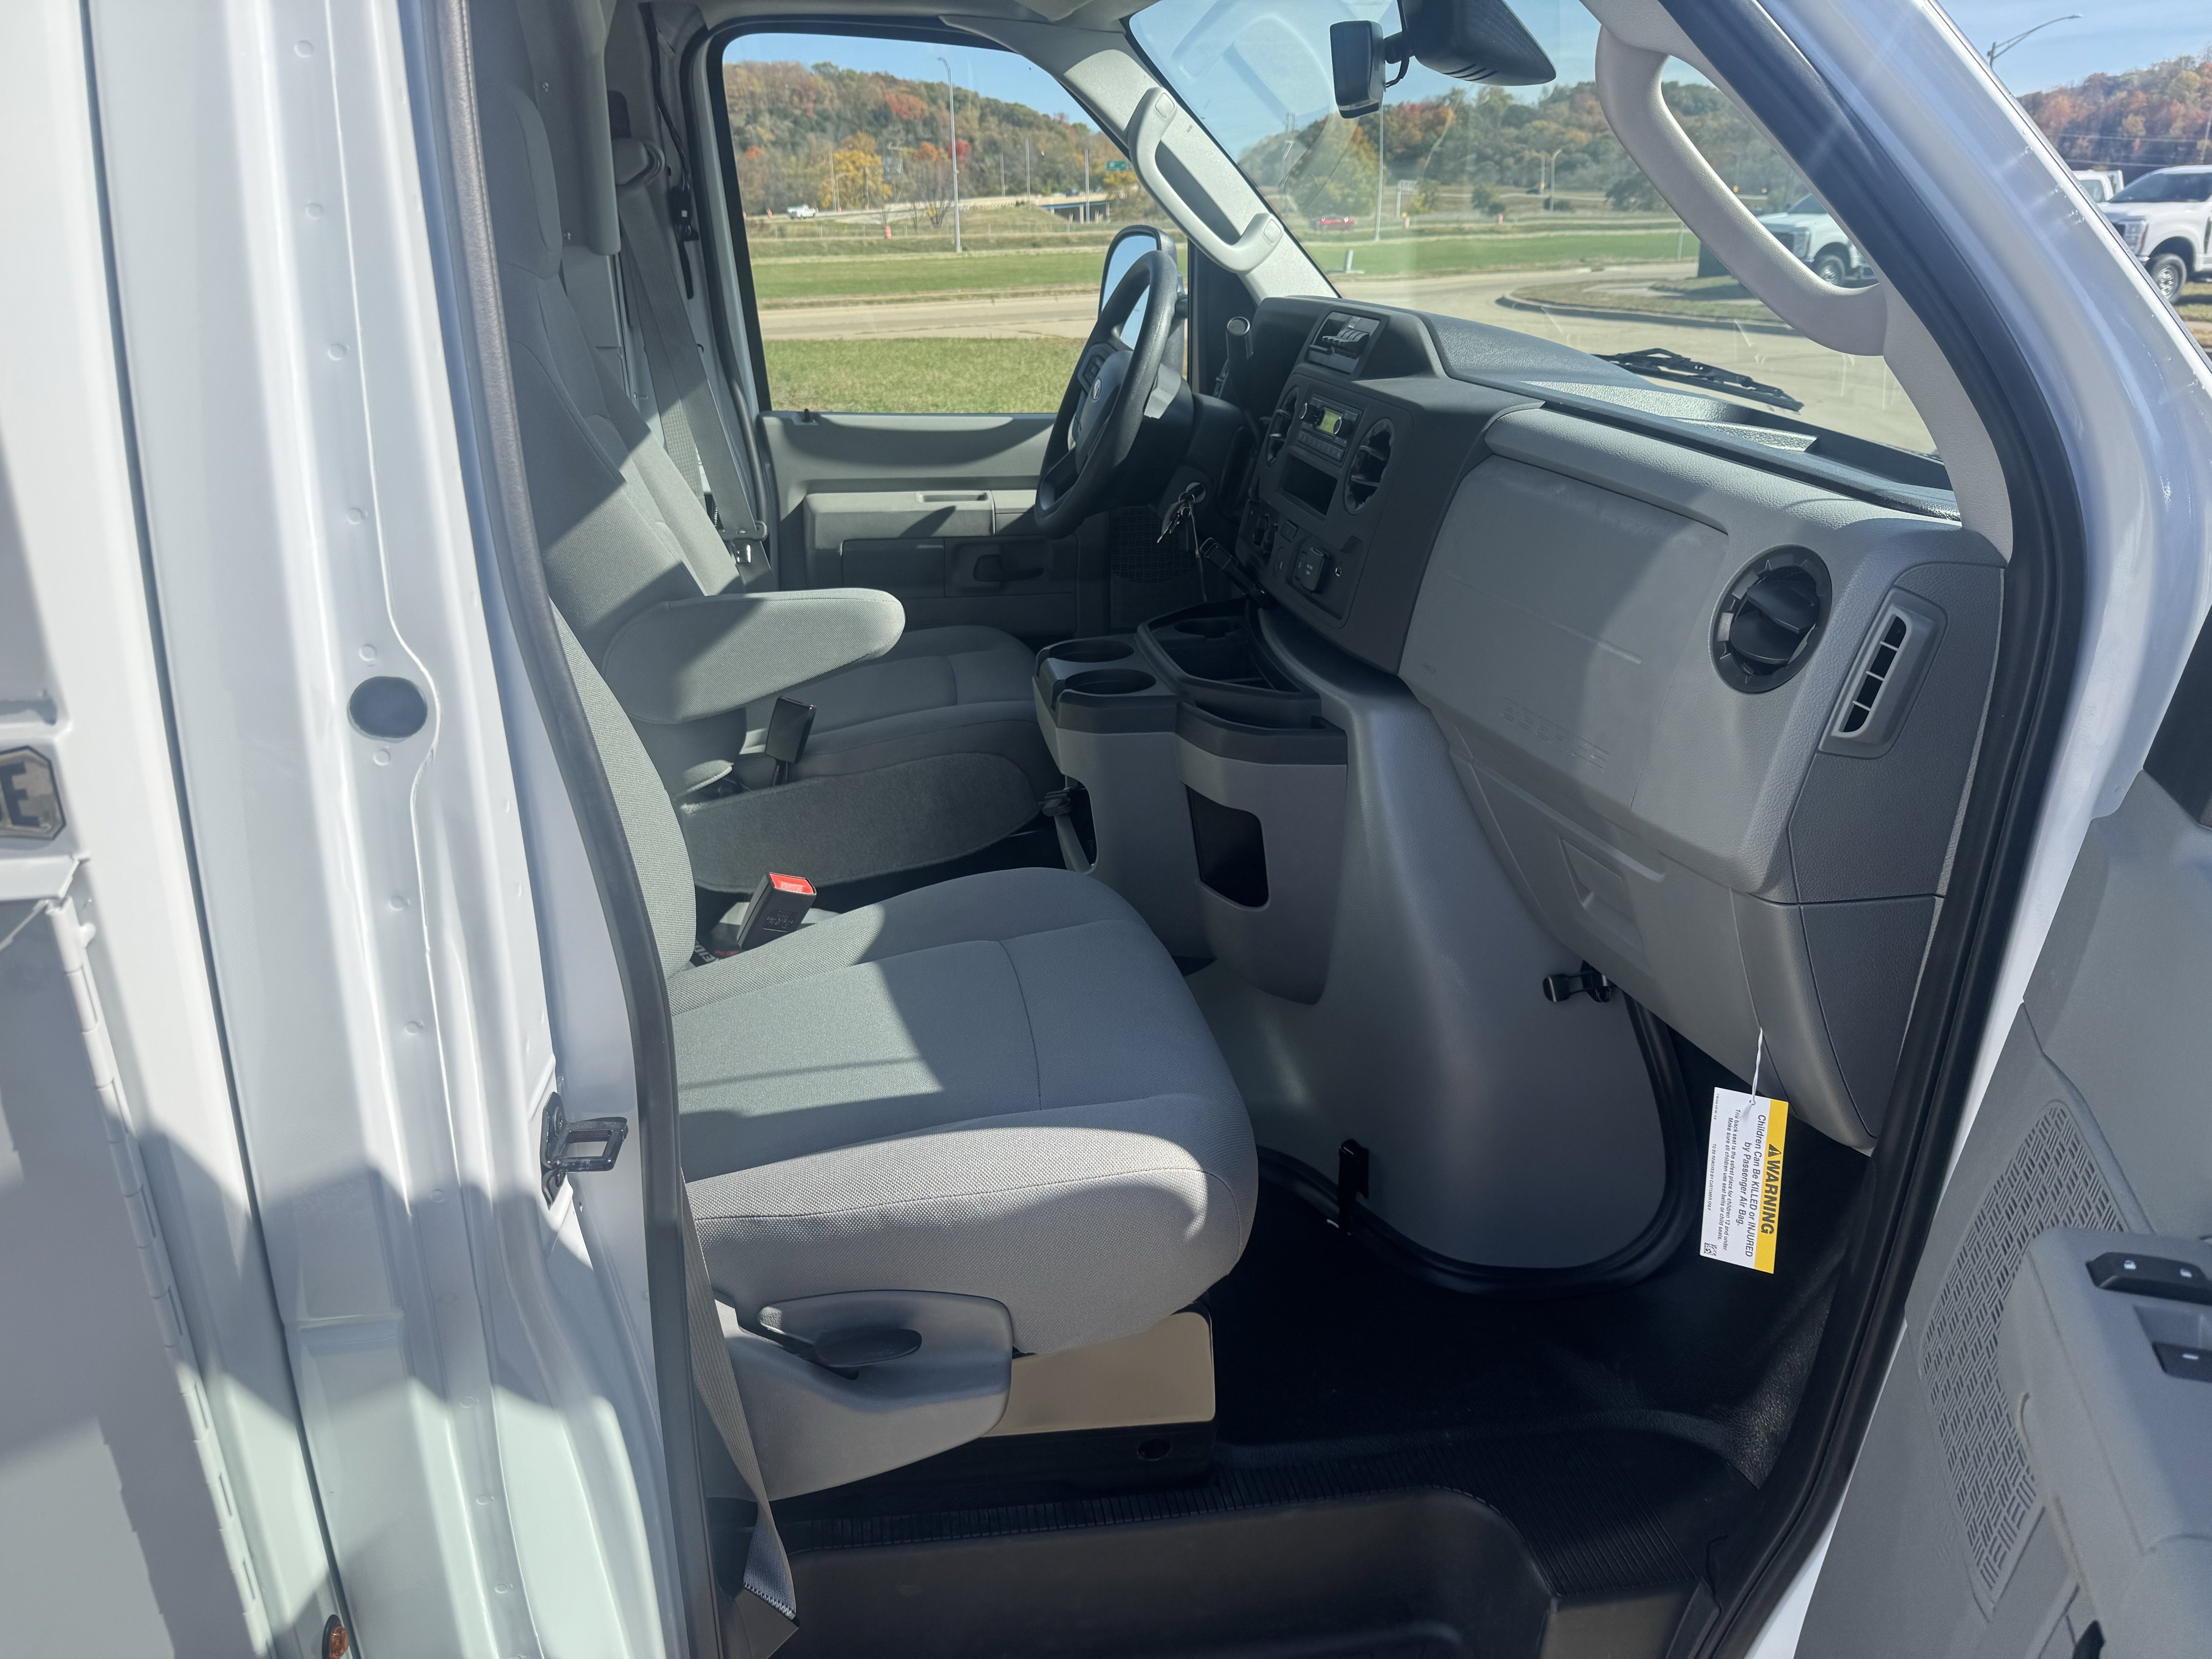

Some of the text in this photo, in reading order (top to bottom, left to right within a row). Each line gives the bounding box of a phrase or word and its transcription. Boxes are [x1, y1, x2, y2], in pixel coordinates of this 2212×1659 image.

[0, 760, 40, 828] E
[1742, 1142, 1753, 1152] by
[1739, 1154, 1751, 1195] Passenger
[1739, 1195, 1748, 1208] Air
[1745, 1115, 1766, 1257] Children Can Be KILLED or INJURED
[1761, 1160, 1781, 1234] WARNING
